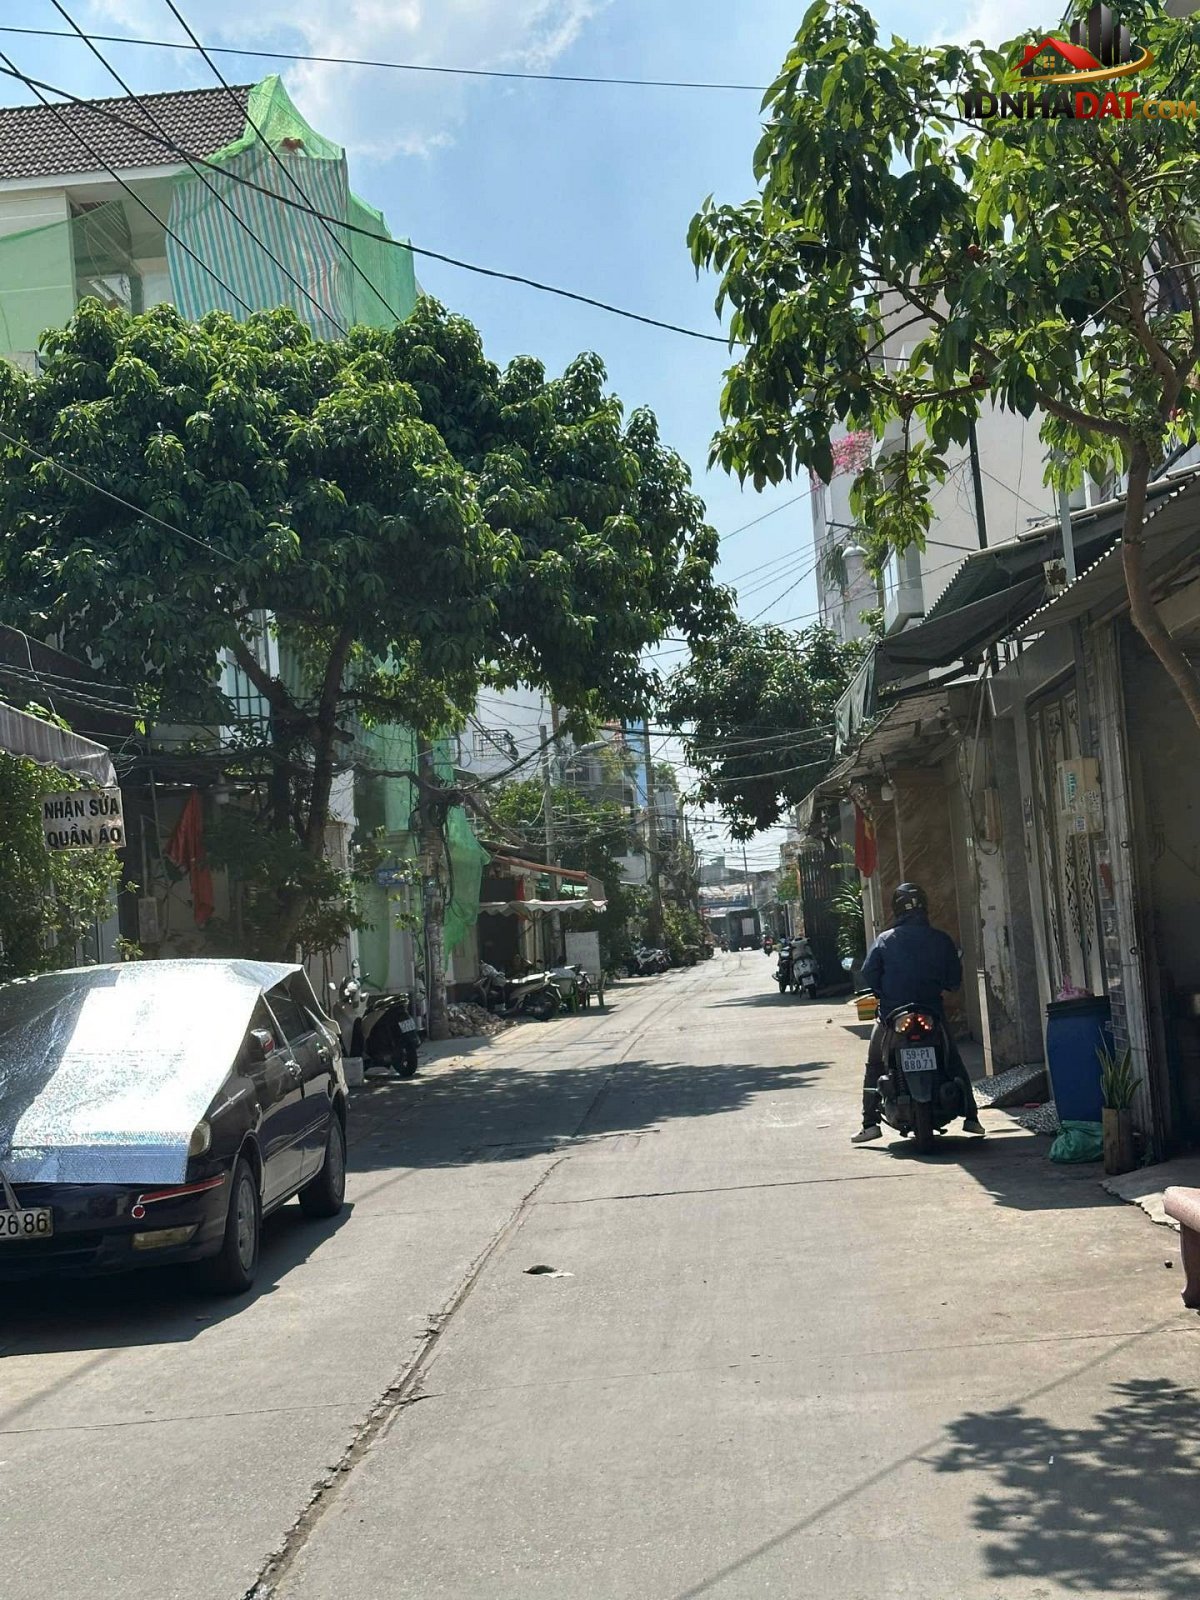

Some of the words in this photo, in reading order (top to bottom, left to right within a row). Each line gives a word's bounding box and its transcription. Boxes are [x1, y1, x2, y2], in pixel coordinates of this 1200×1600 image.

[44, 796, 85, 821] NHẬN
[89, 792, 119, 817] SỬA
[47, 823, 93, 850] QUẦN
[99, 824, 121, 845] ÁO
[905, 1049, 930, 1060] 59-P1
